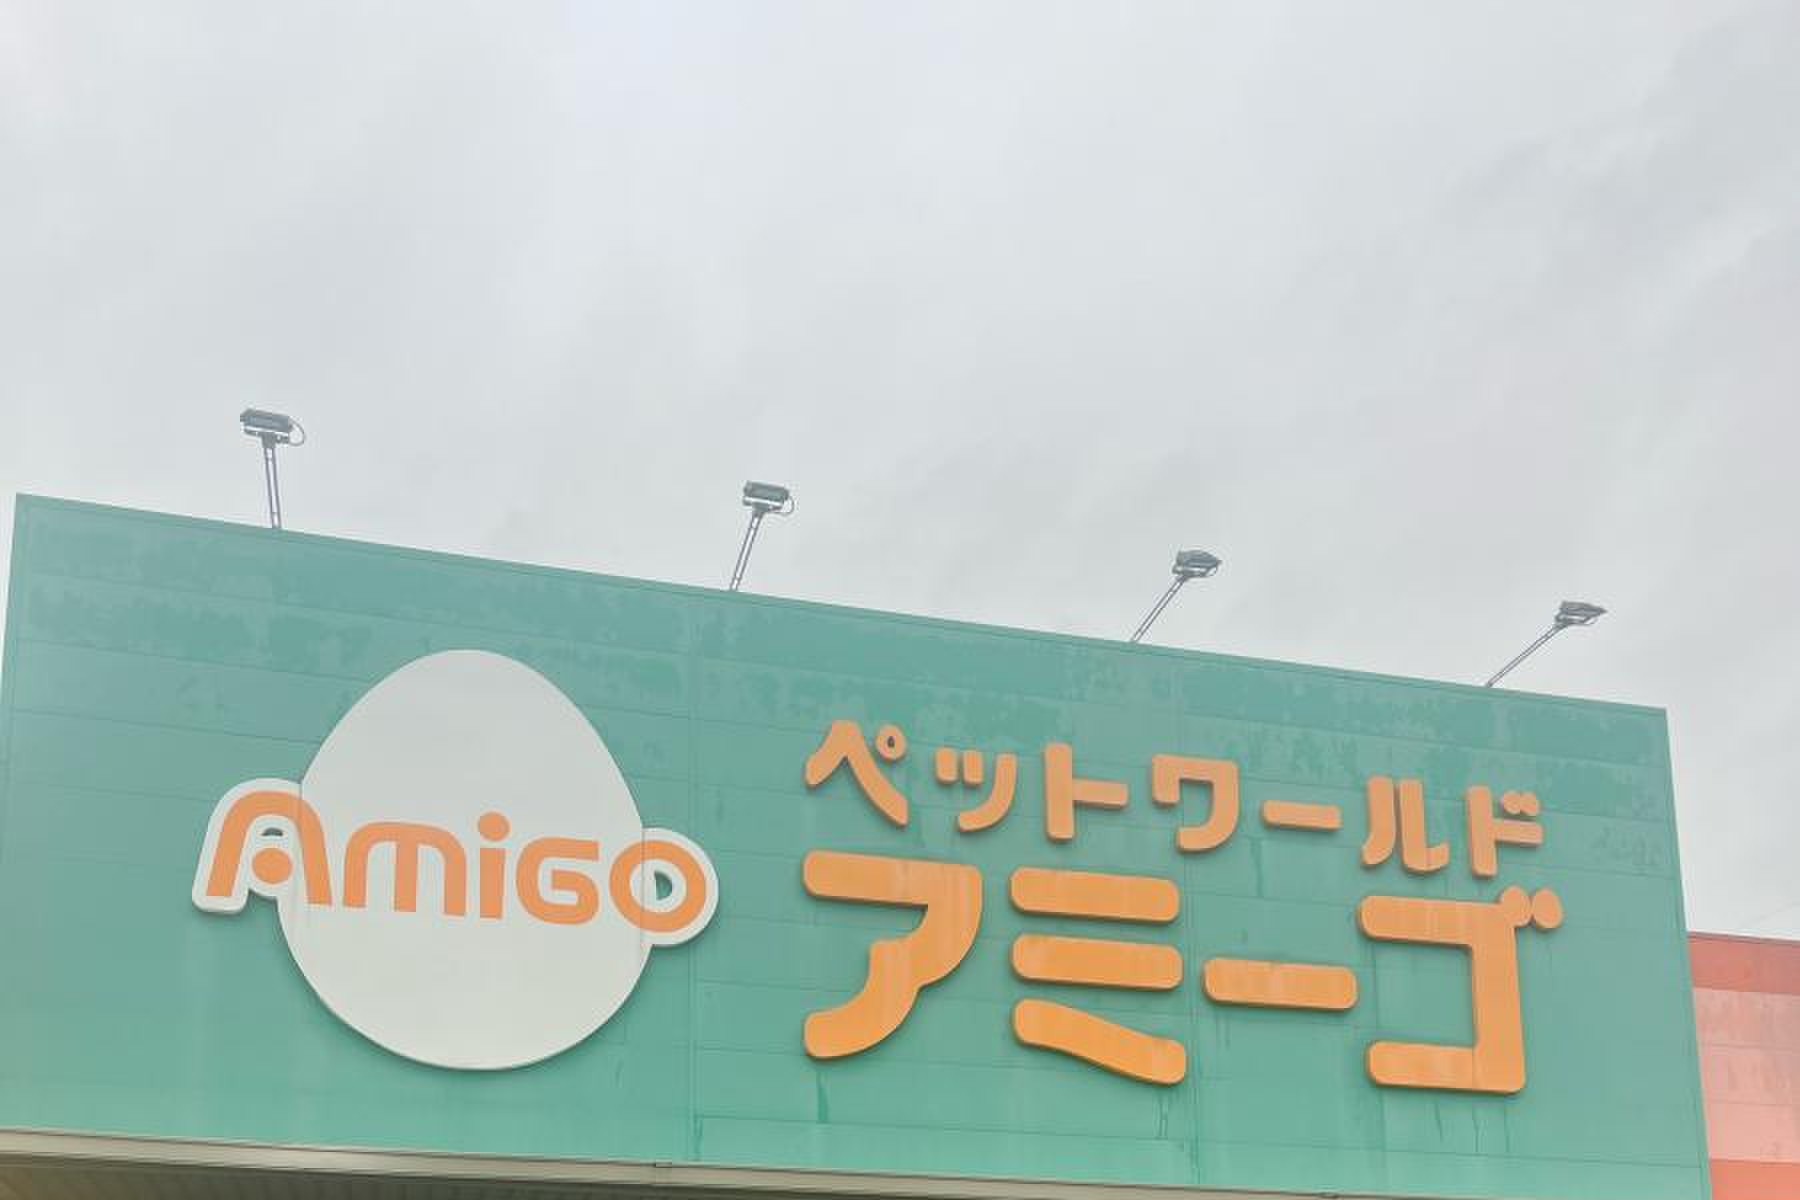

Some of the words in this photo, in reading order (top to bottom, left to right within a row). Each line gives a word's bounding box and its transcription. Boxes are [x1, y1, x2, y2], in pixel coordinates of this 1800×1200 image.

[804, 719, 1545, 879] ペットワールド
[803, 849, 1564, 1094] アミーゴ
